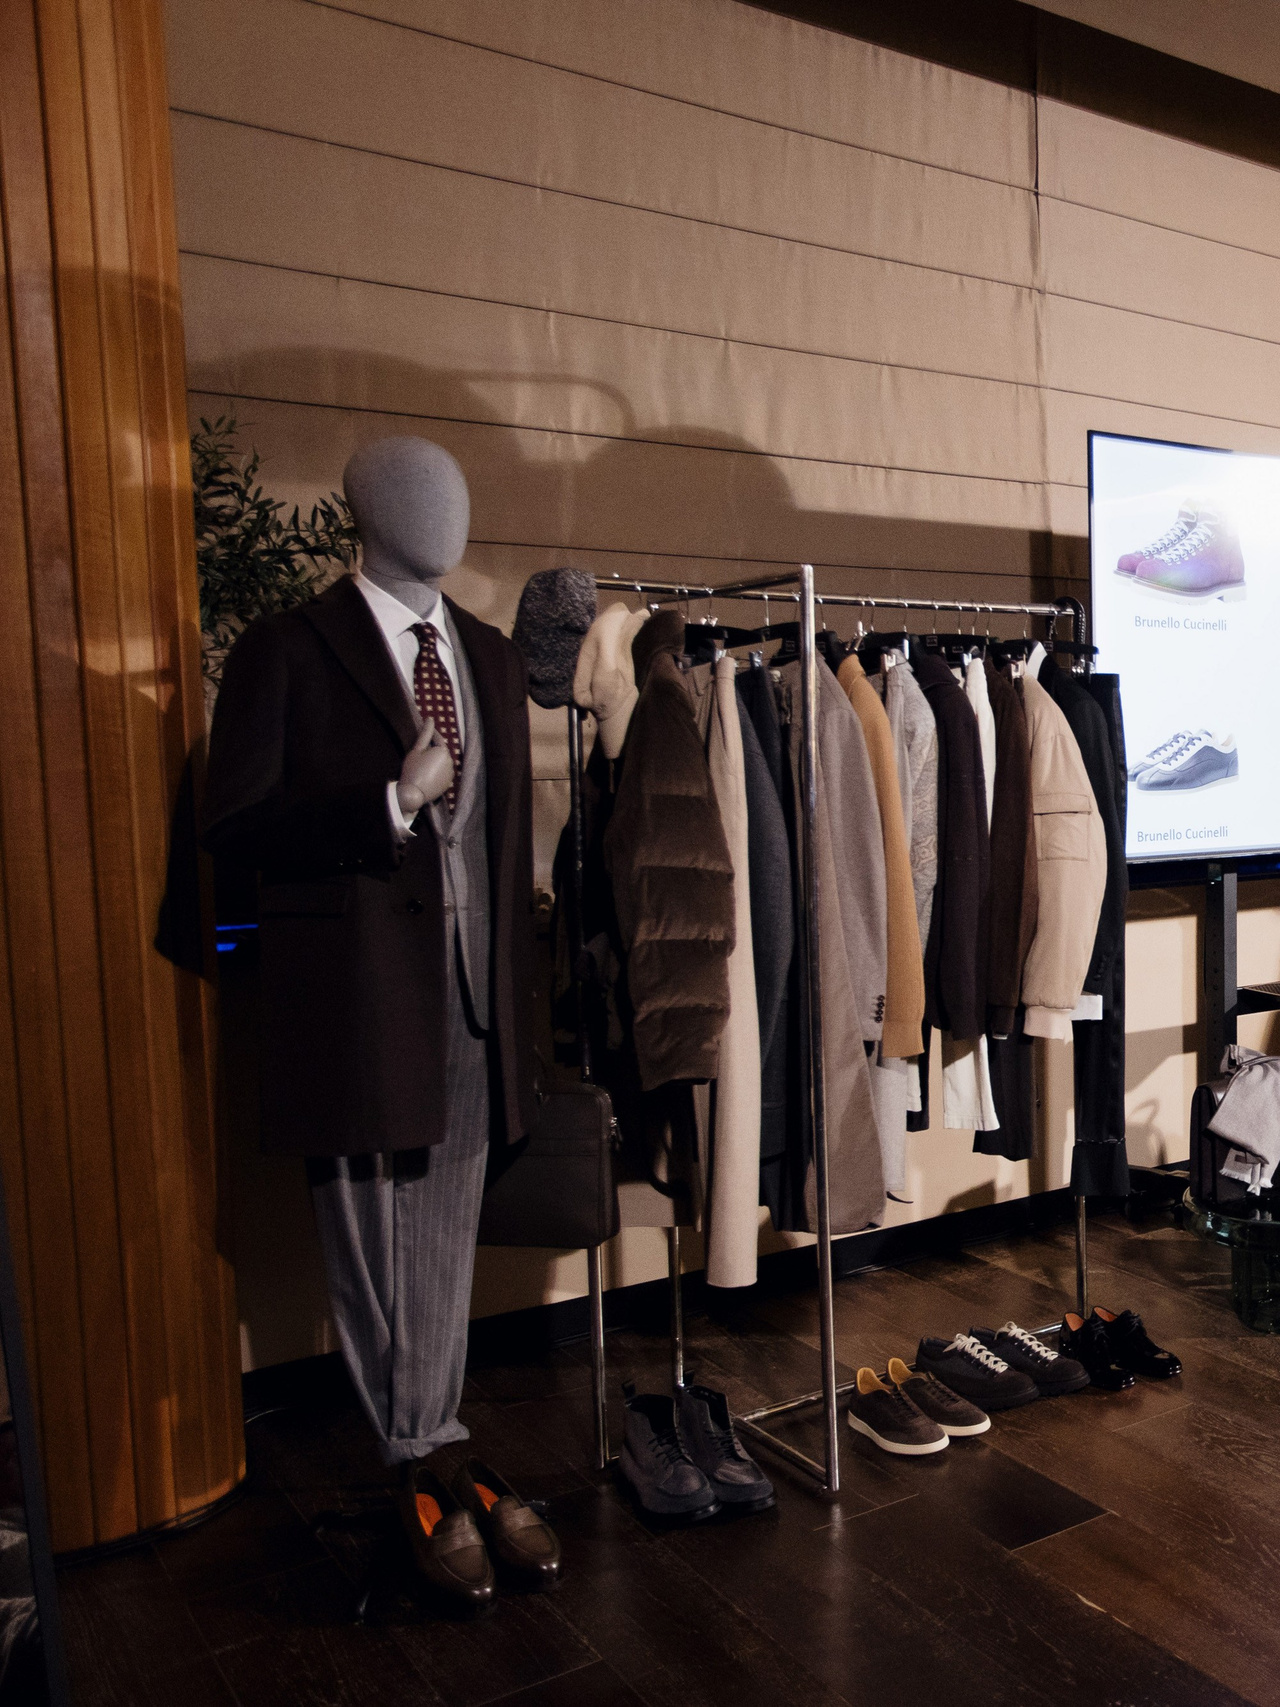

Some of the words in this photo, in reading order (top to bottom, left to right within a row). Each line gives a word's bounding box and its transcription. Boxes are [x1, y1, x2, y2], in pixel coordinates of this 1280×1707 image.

[1134, 615, 1180, 629] Brunello
[1183, 618, 1227, 631] Cucinelli
[1137, 829, 1182, 842] Brunello
[1185, 826, 1228, 839] Cucinelli
